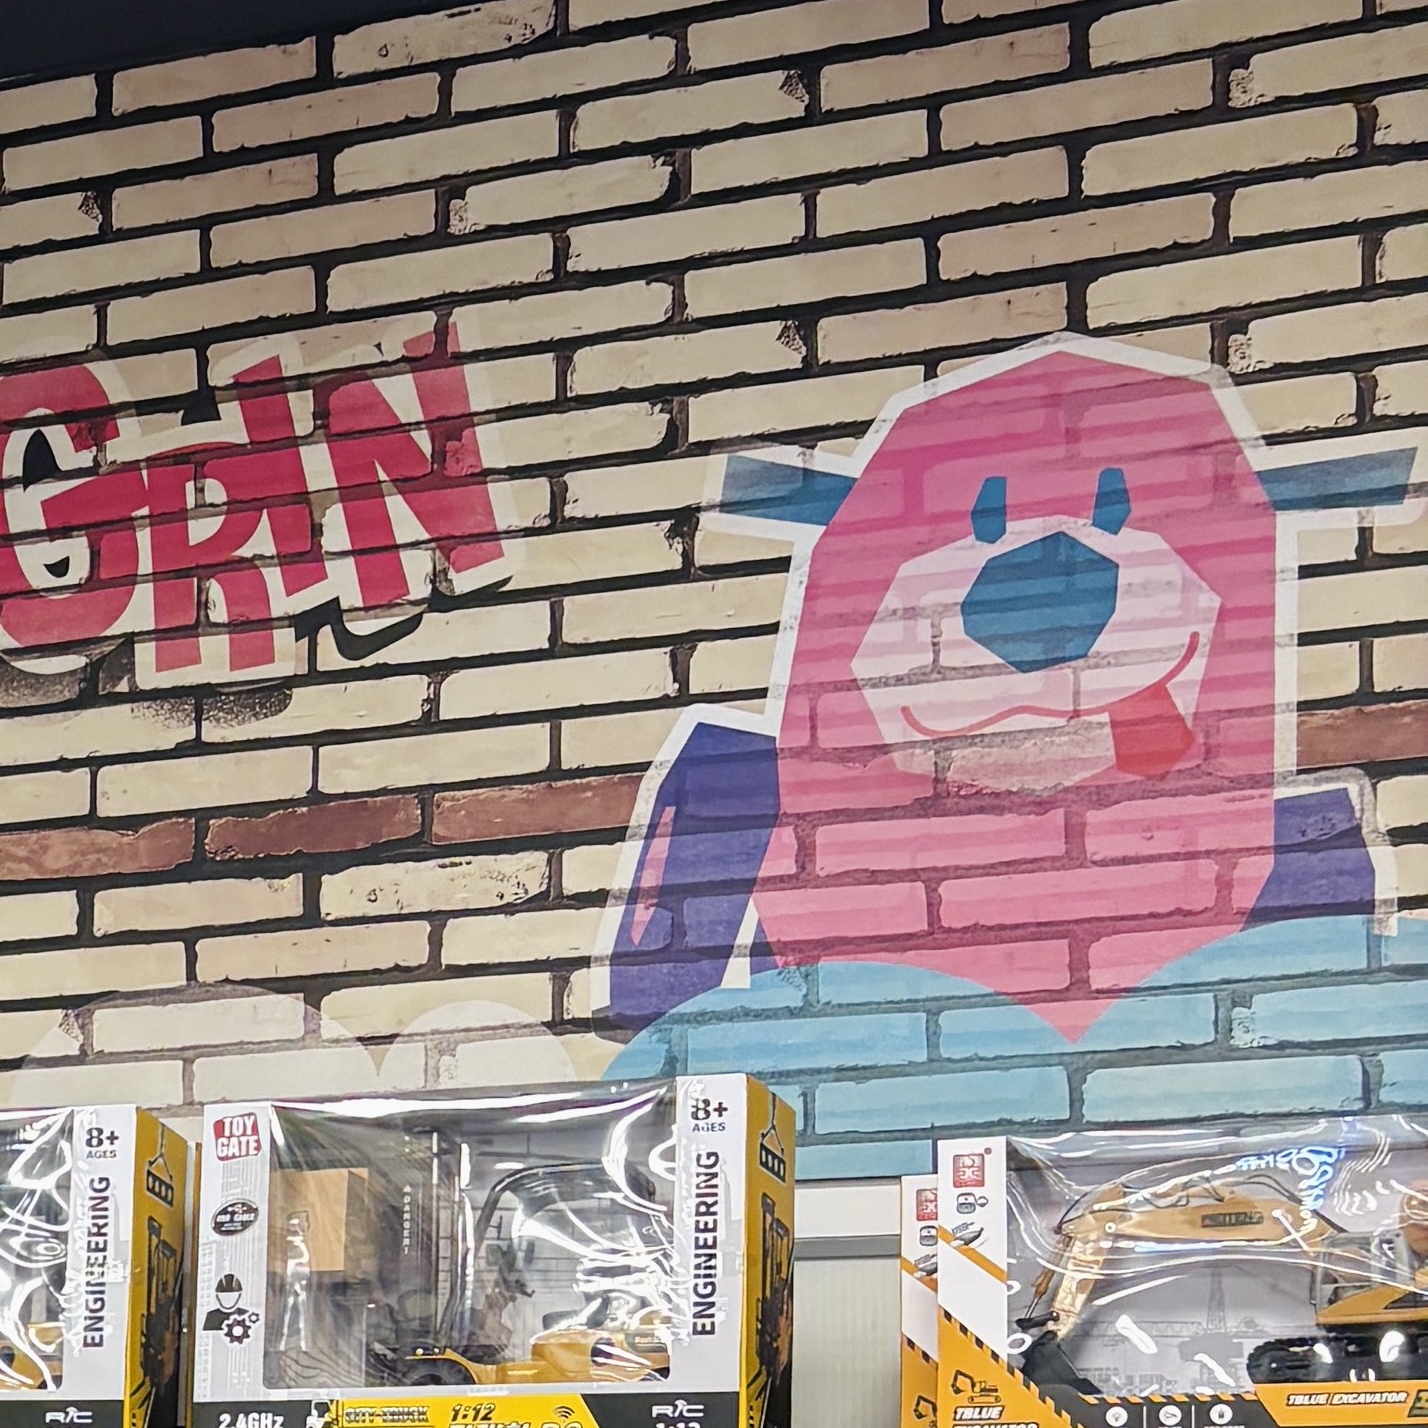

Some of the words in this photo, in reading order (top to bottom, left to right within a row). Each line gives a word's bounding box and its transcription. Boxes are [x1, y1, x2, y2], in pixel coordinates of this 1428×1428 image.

[222, 1114, 256, 1136] TOY
[85, 1127, 119, 1148] 8+
[216, 1134, 259, 1160] GATE
[86, 1148, 117, 1159] AGES
[691, 1149, 720, 1336] ENGINEERING
[82, 1175, 111, 1349] ENGINEERING
[953, 1405, 1005, 1421] TBLUE
